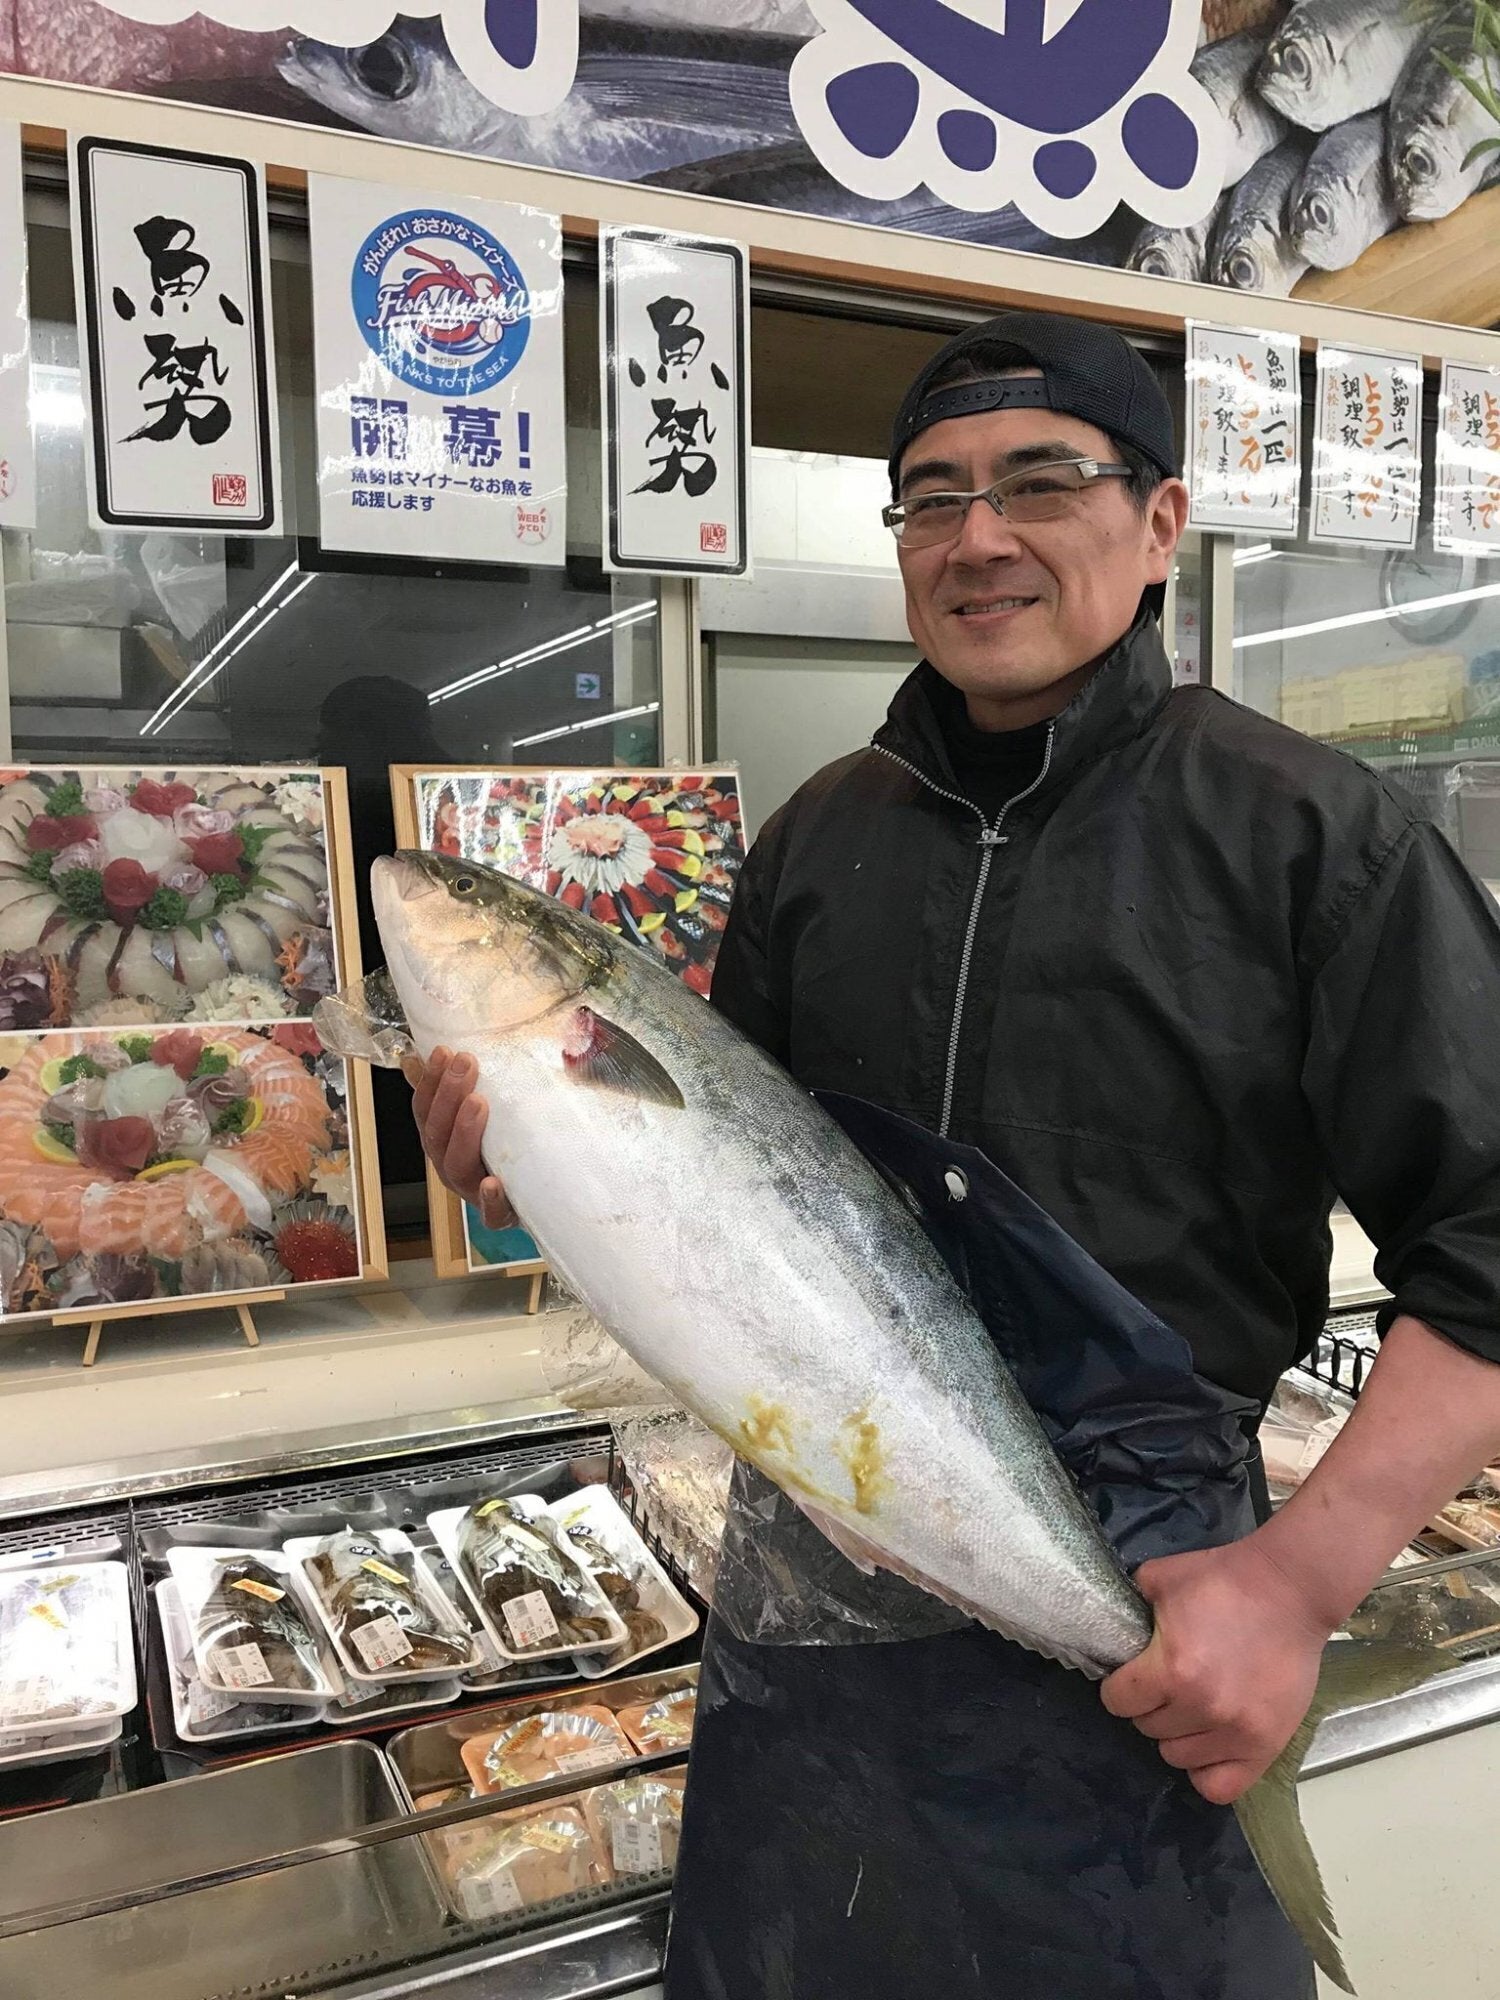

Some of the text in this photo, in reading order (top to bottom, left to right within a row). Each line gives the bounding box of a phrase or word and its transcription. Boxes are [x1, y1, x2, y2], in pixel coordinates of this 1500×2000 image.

[113, 216, 244, 445] 魚勢
[485, 356, 509, 378] SEA
[627, 296, 729, 497] 魚勢
[351, 490, 435, 511] 応援します
